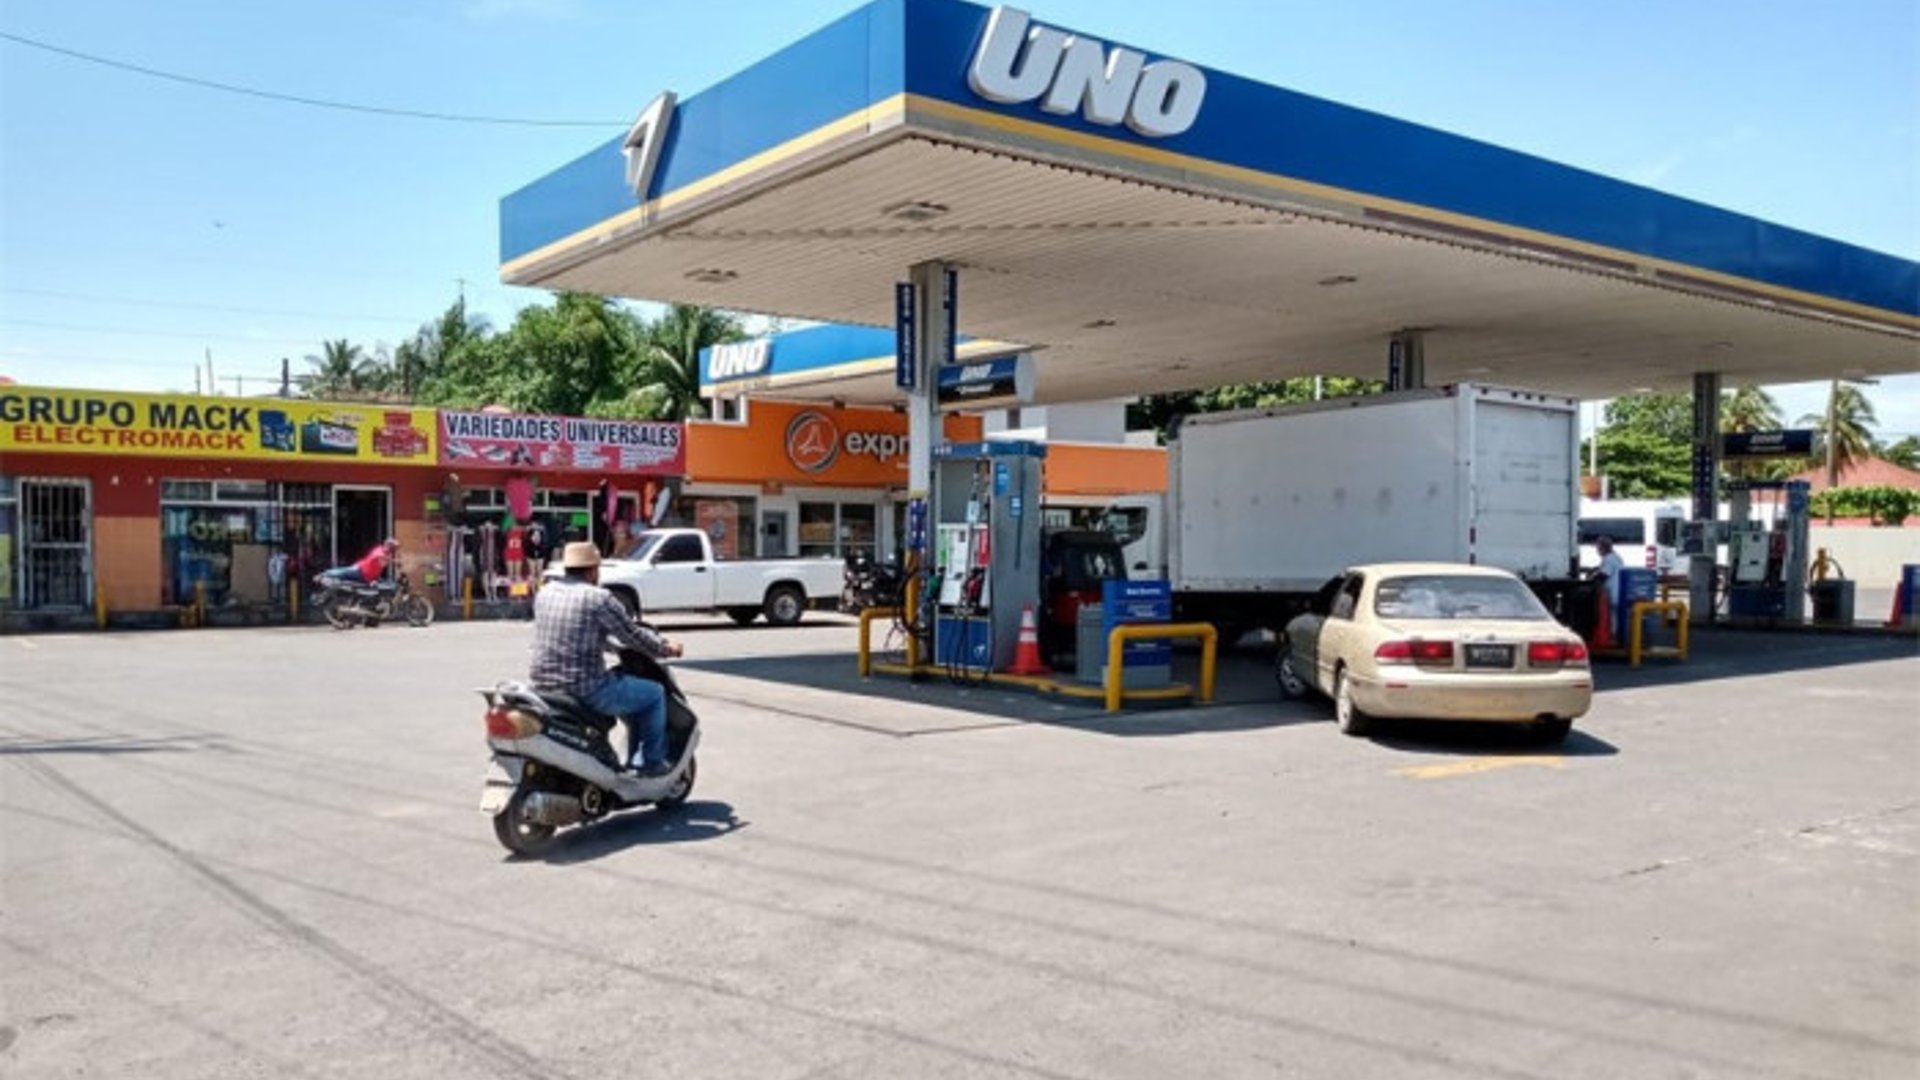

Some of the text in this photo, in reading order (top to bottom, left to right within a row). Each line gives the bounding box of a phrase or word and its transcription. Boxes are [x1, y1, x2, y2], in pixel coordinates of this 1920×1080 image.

[967, 5, 1207, 137] UNO
[708, 339, 768, 379] UNO
[0, 396, 253, 432] GRUPO MACK
[446, 414, 679, 447] VARIEDADES UNIVERSALES
[13, 425, 245, 450] ELECTROMACK
[845, 431, 910, 461] expr
